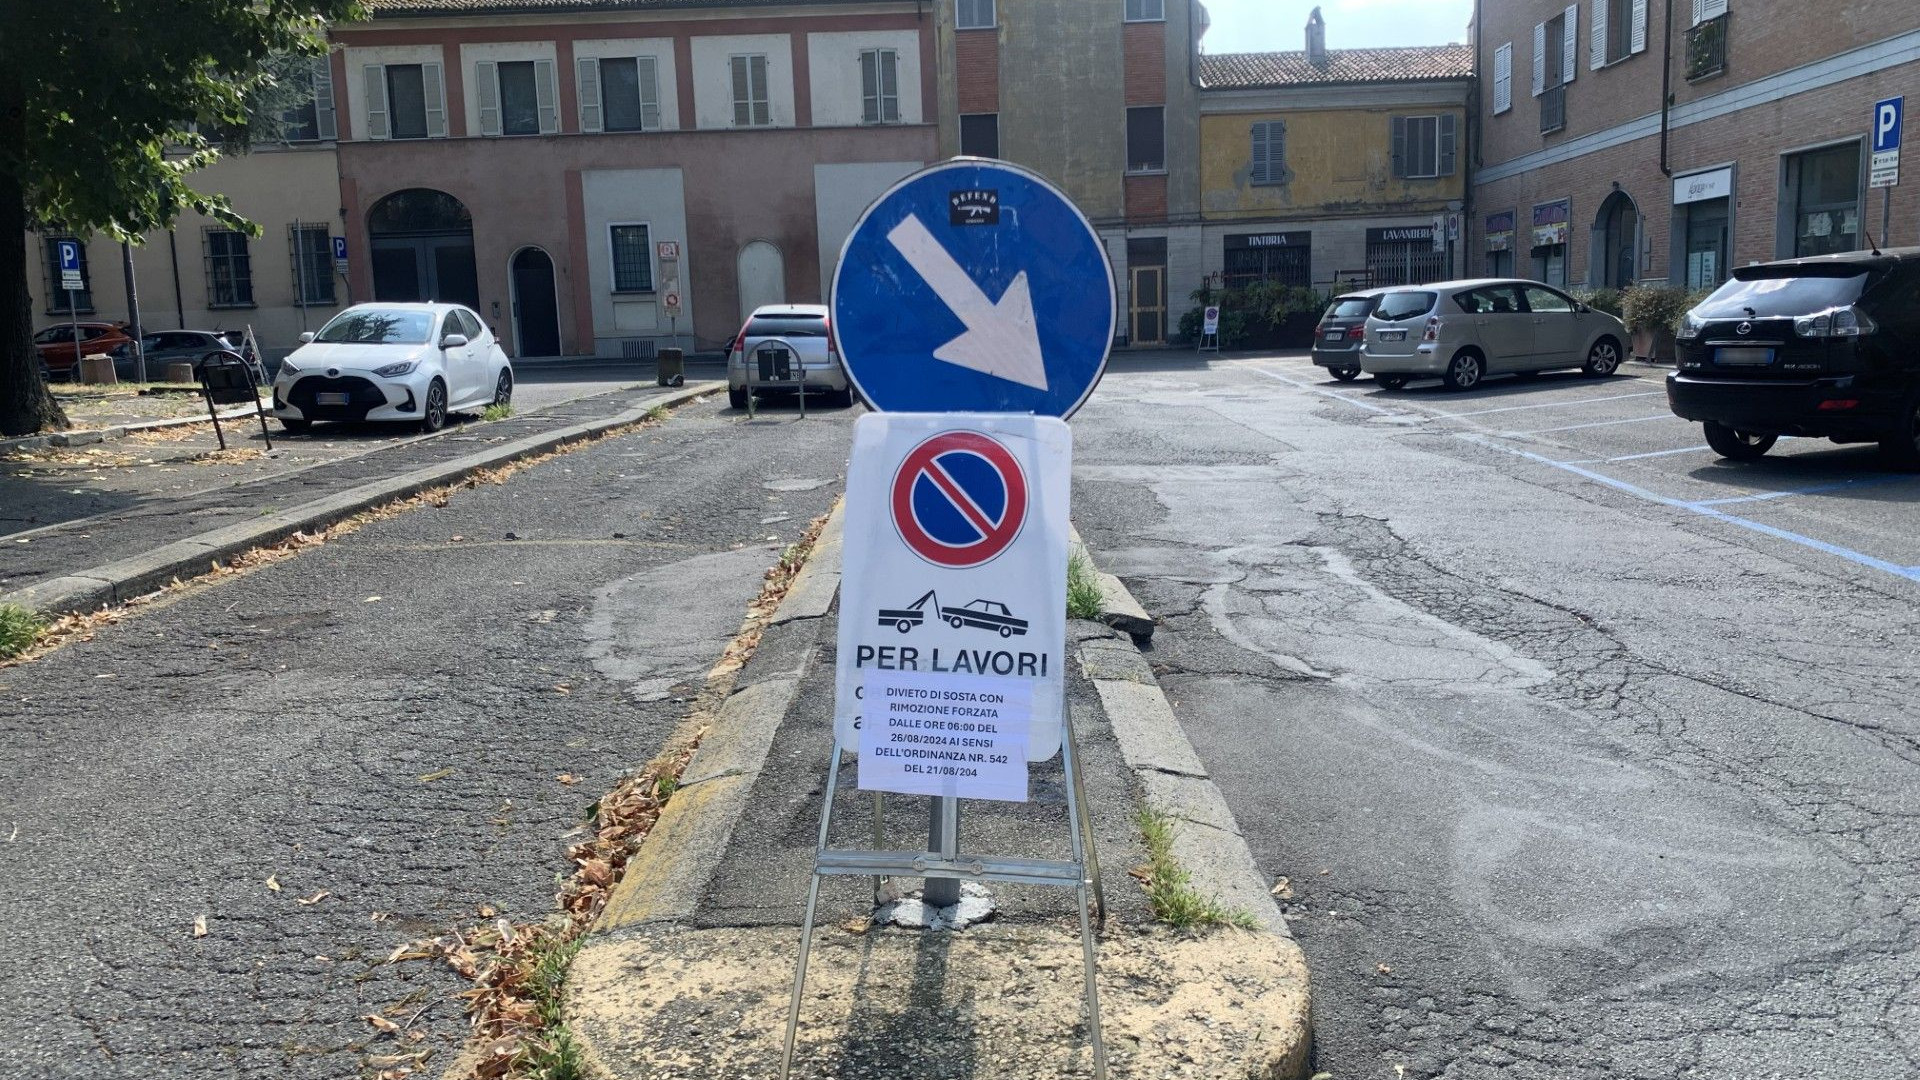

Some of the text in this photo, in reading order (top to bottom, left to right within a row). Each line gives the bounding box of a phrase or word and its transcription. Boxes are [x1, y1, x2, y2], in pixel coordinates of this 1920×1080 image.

[1878, 104, 1896, 147] P
[951, 191, 997, 206] DEFEND
[62, 244, 75, 267] P
[335, 239, 345, 257] P
[856, 644, 1048, 677] PER LAVORI
[886, 687, 1004, 704] DIVIETO DI SOSTA CON
[890, 702, 999, 719] RIMOZIONE FORZATA
[889, 718, 998, 734] DALLE ORE 06:00 DEL
[890, 733, 993, 748] 26/08/2024 AI SENSI
[875, 747, 1008, 764] DELL'ORDINANZA NR. 542
[904, 764, 978, 777] DEL 21/08/204
